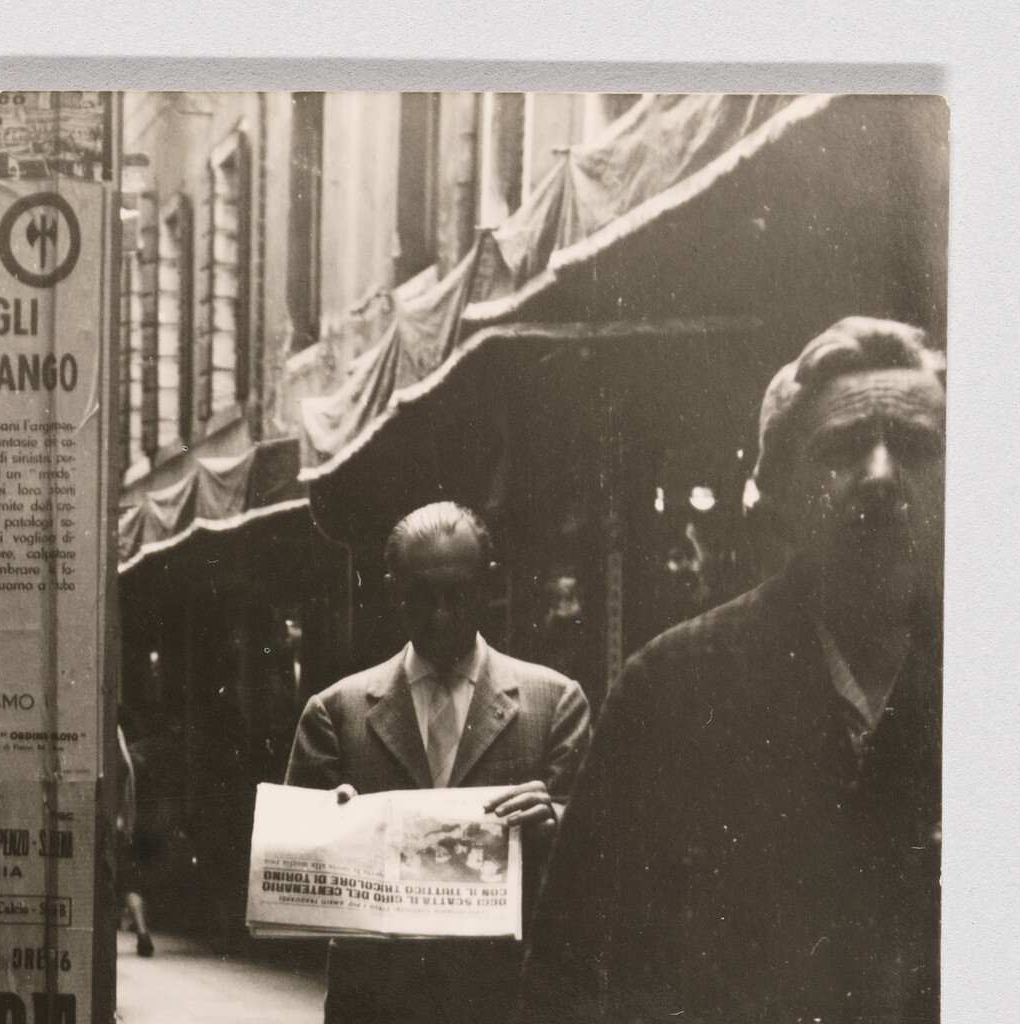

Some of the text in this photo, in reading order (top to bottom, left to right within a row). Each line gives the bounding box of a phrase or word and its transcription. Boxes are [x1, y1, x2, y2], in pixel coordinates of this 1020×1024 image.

[7, 471, 21, 479] un
[18, 484, 41, 495] loro
[262, 881, 506, 906] OGGI SCATTA IL GIRO DEL CENTENARIO
[263, 870, 508, 896] CON IL TRITTICO TRICOLORE DI TORINO
[12, 948, 46, 970] ORE
